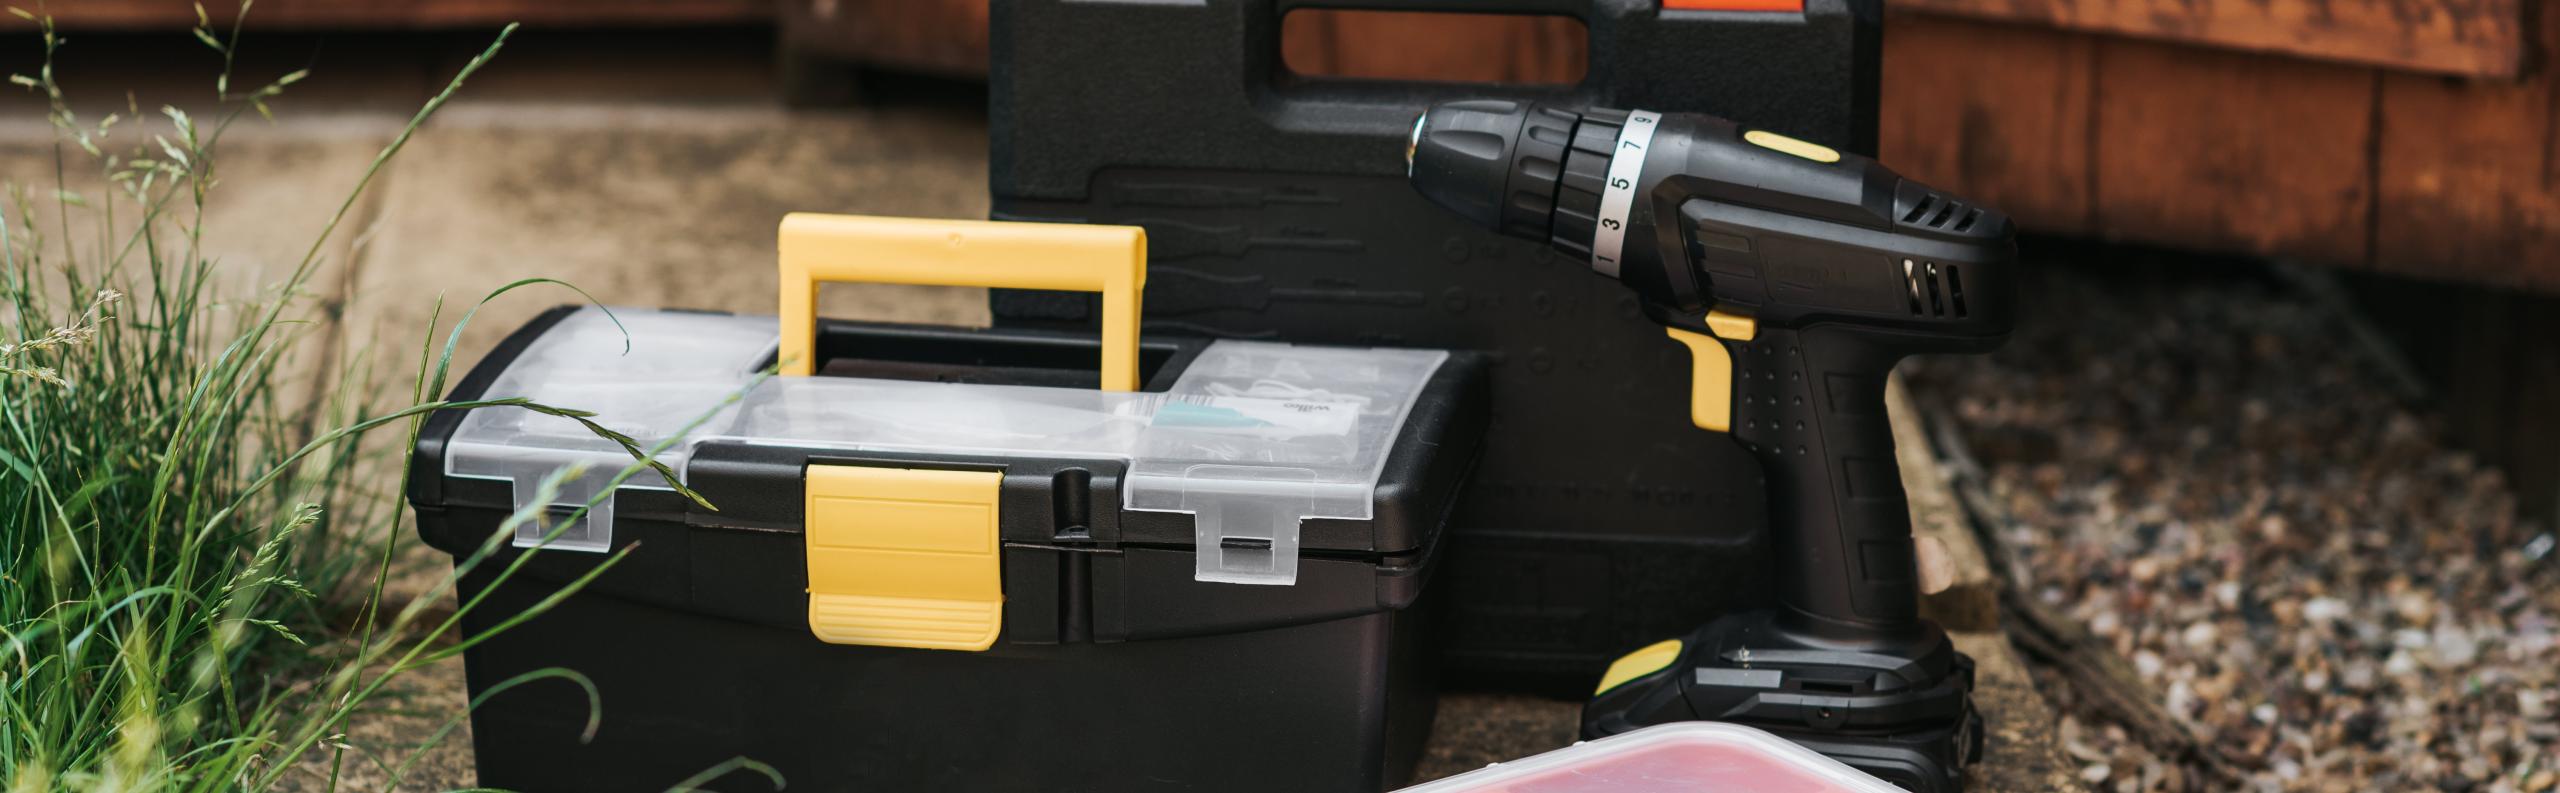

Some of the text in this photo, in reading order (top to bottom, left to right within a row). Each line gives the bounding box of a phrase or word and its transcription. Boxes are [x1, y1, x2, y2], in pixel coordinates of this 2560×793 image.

[1597, 116, 1652, 263] 1 3 5 7 9
